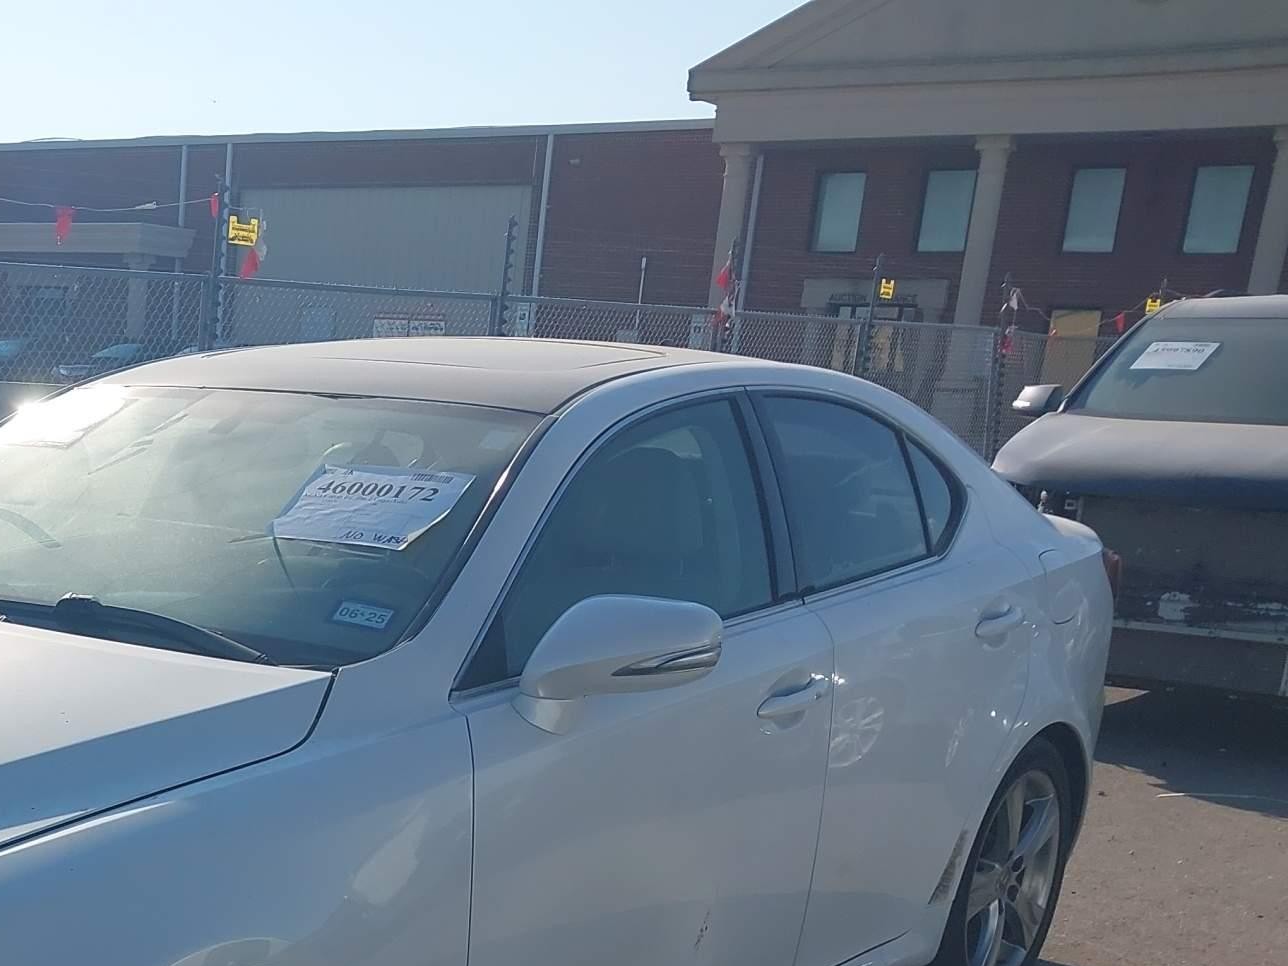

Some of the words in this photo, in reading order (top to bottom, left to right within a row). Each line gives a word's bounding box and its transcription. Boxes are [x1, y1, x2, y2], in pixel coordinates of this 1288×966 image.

[317, 480, 440, 502] 46000172
[340, 530, 364, 540] NO
[365, 612, 388, 624] 25
